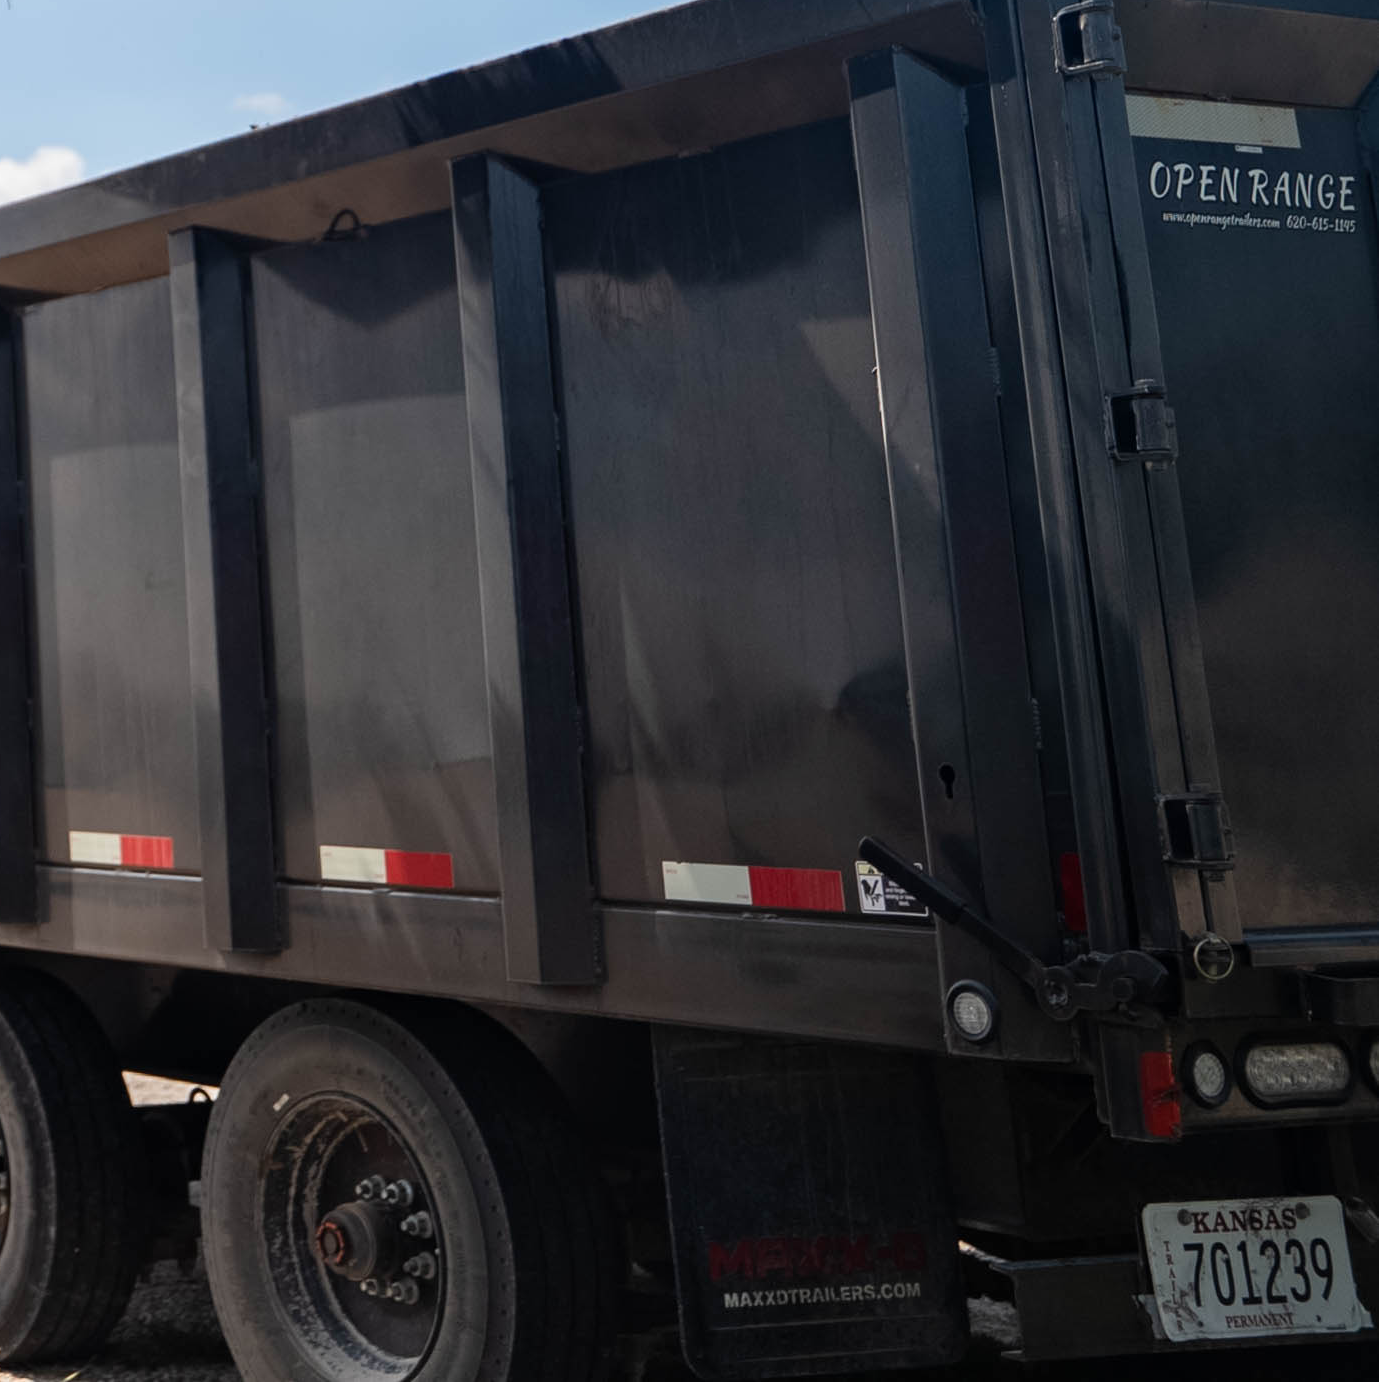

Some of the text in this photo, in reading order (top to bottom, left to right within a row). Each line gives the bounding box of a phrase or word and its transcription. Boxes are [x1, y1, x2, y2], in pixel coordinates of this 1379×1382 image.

[1149, 161, 1356, 212] OPEN RANGE
[1286, 214, 1356, 234] 620-615-1145
[1191, 1207, 1297, 1234] KANSAS
[1182, 1237, 1334, 1308] 701239
[723, 1282, 922, 1309] MAXXDTRAILERS.COM
[1224, 1312, 1296, 1330] PERMANENT
